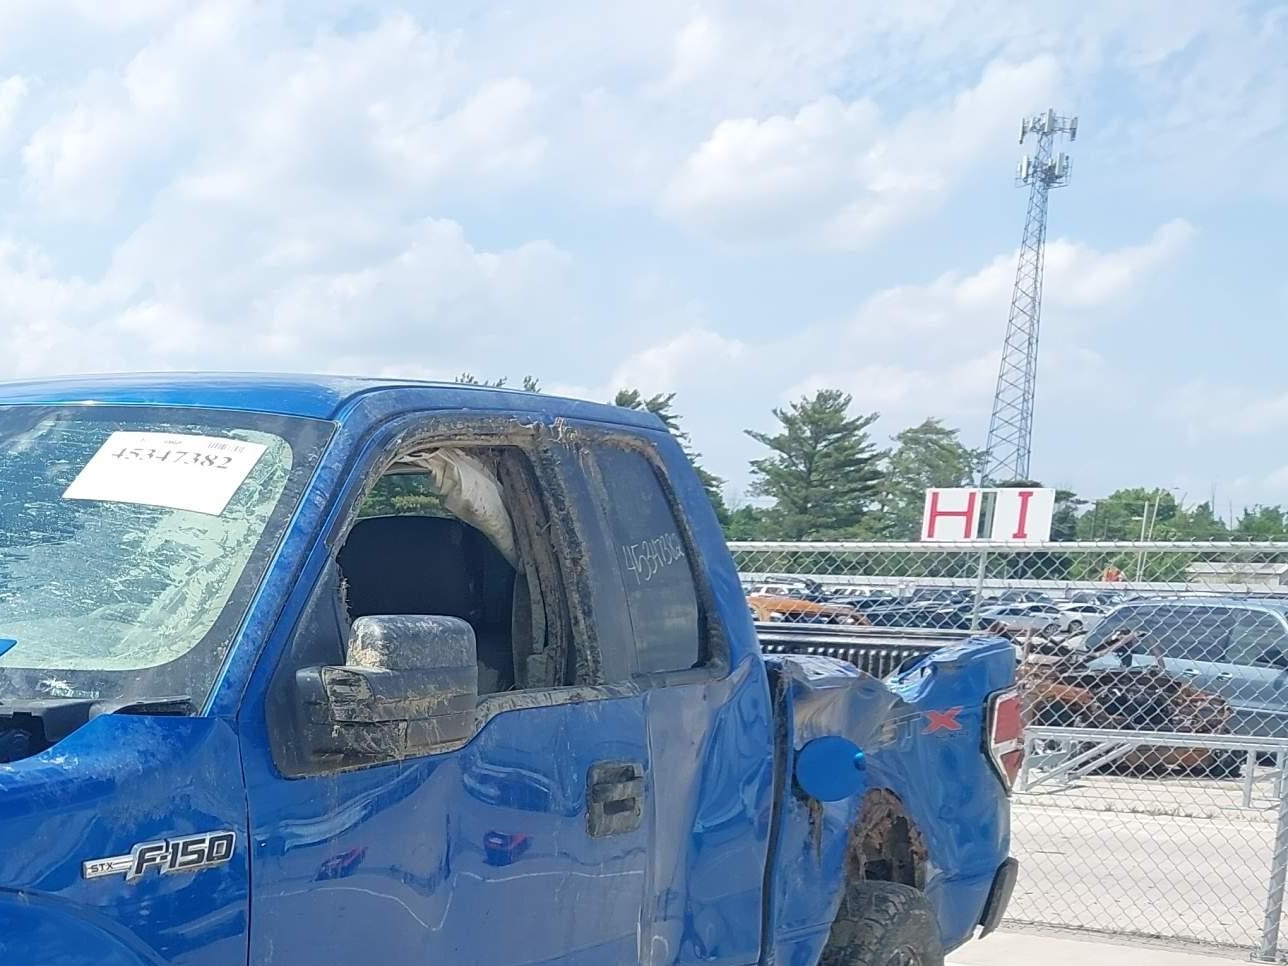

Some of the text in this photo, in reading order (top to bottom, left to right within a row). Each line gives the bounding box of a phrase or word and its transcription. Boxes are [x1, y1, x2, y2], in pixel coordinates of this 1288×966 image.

[111, 447, 233, 470] 45347382
[90, 832, 236, 879] STX F-150
